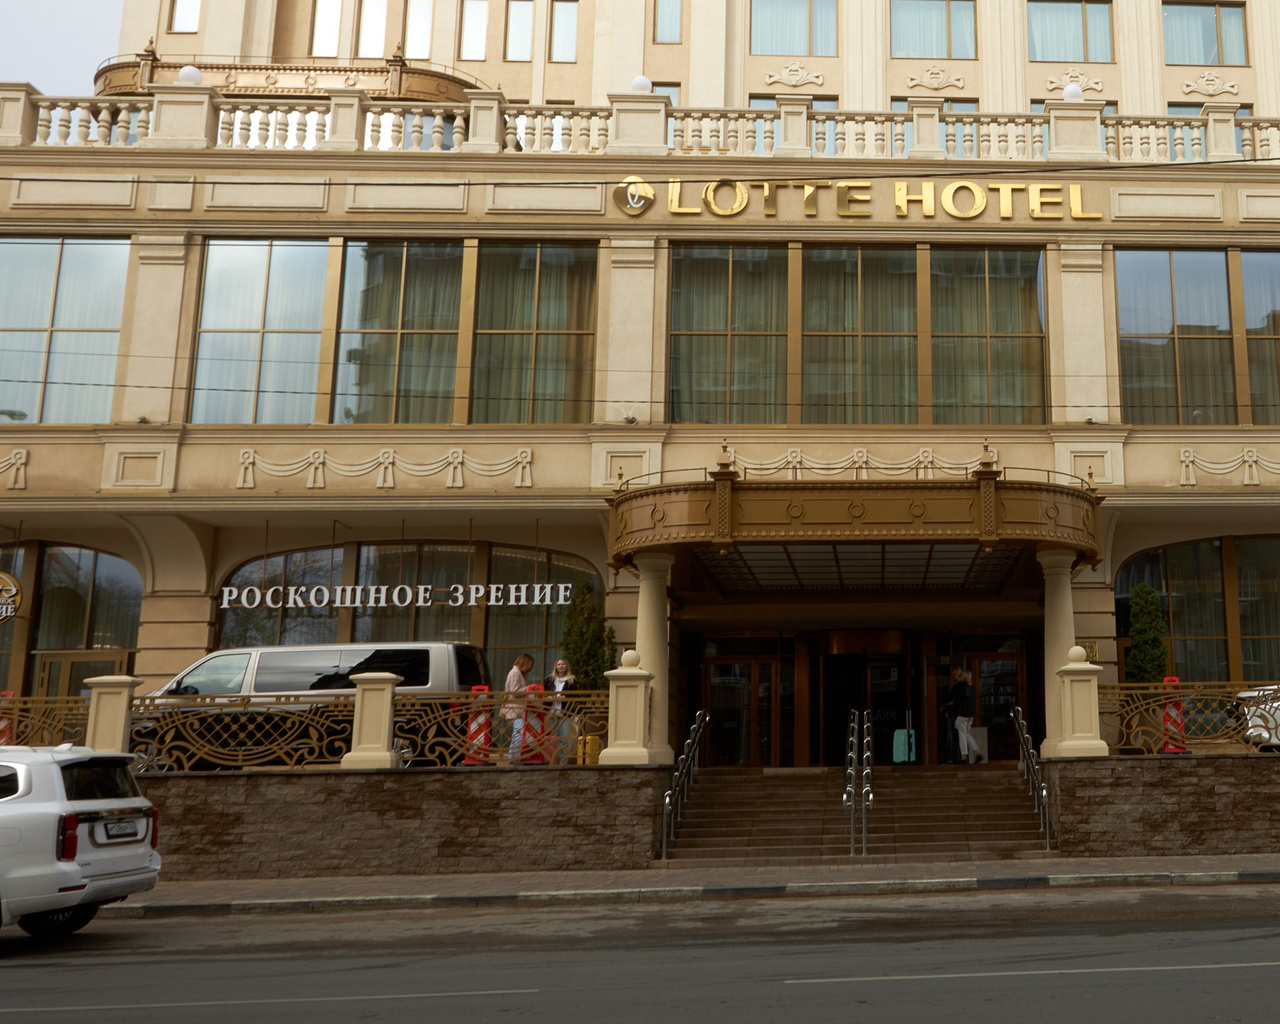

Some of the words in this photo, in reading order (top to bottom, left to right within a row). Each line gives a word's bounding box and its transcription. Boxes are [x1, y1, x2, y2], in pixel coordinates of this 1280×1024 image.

[667, 179, 872, 217] LOTTE
[895, 180, 1103, 220] HOTEL
[220, 584, 433, 608] РОСКОШНОЕ
[448, 583, 573, 606] ЗРЕНИЕ
